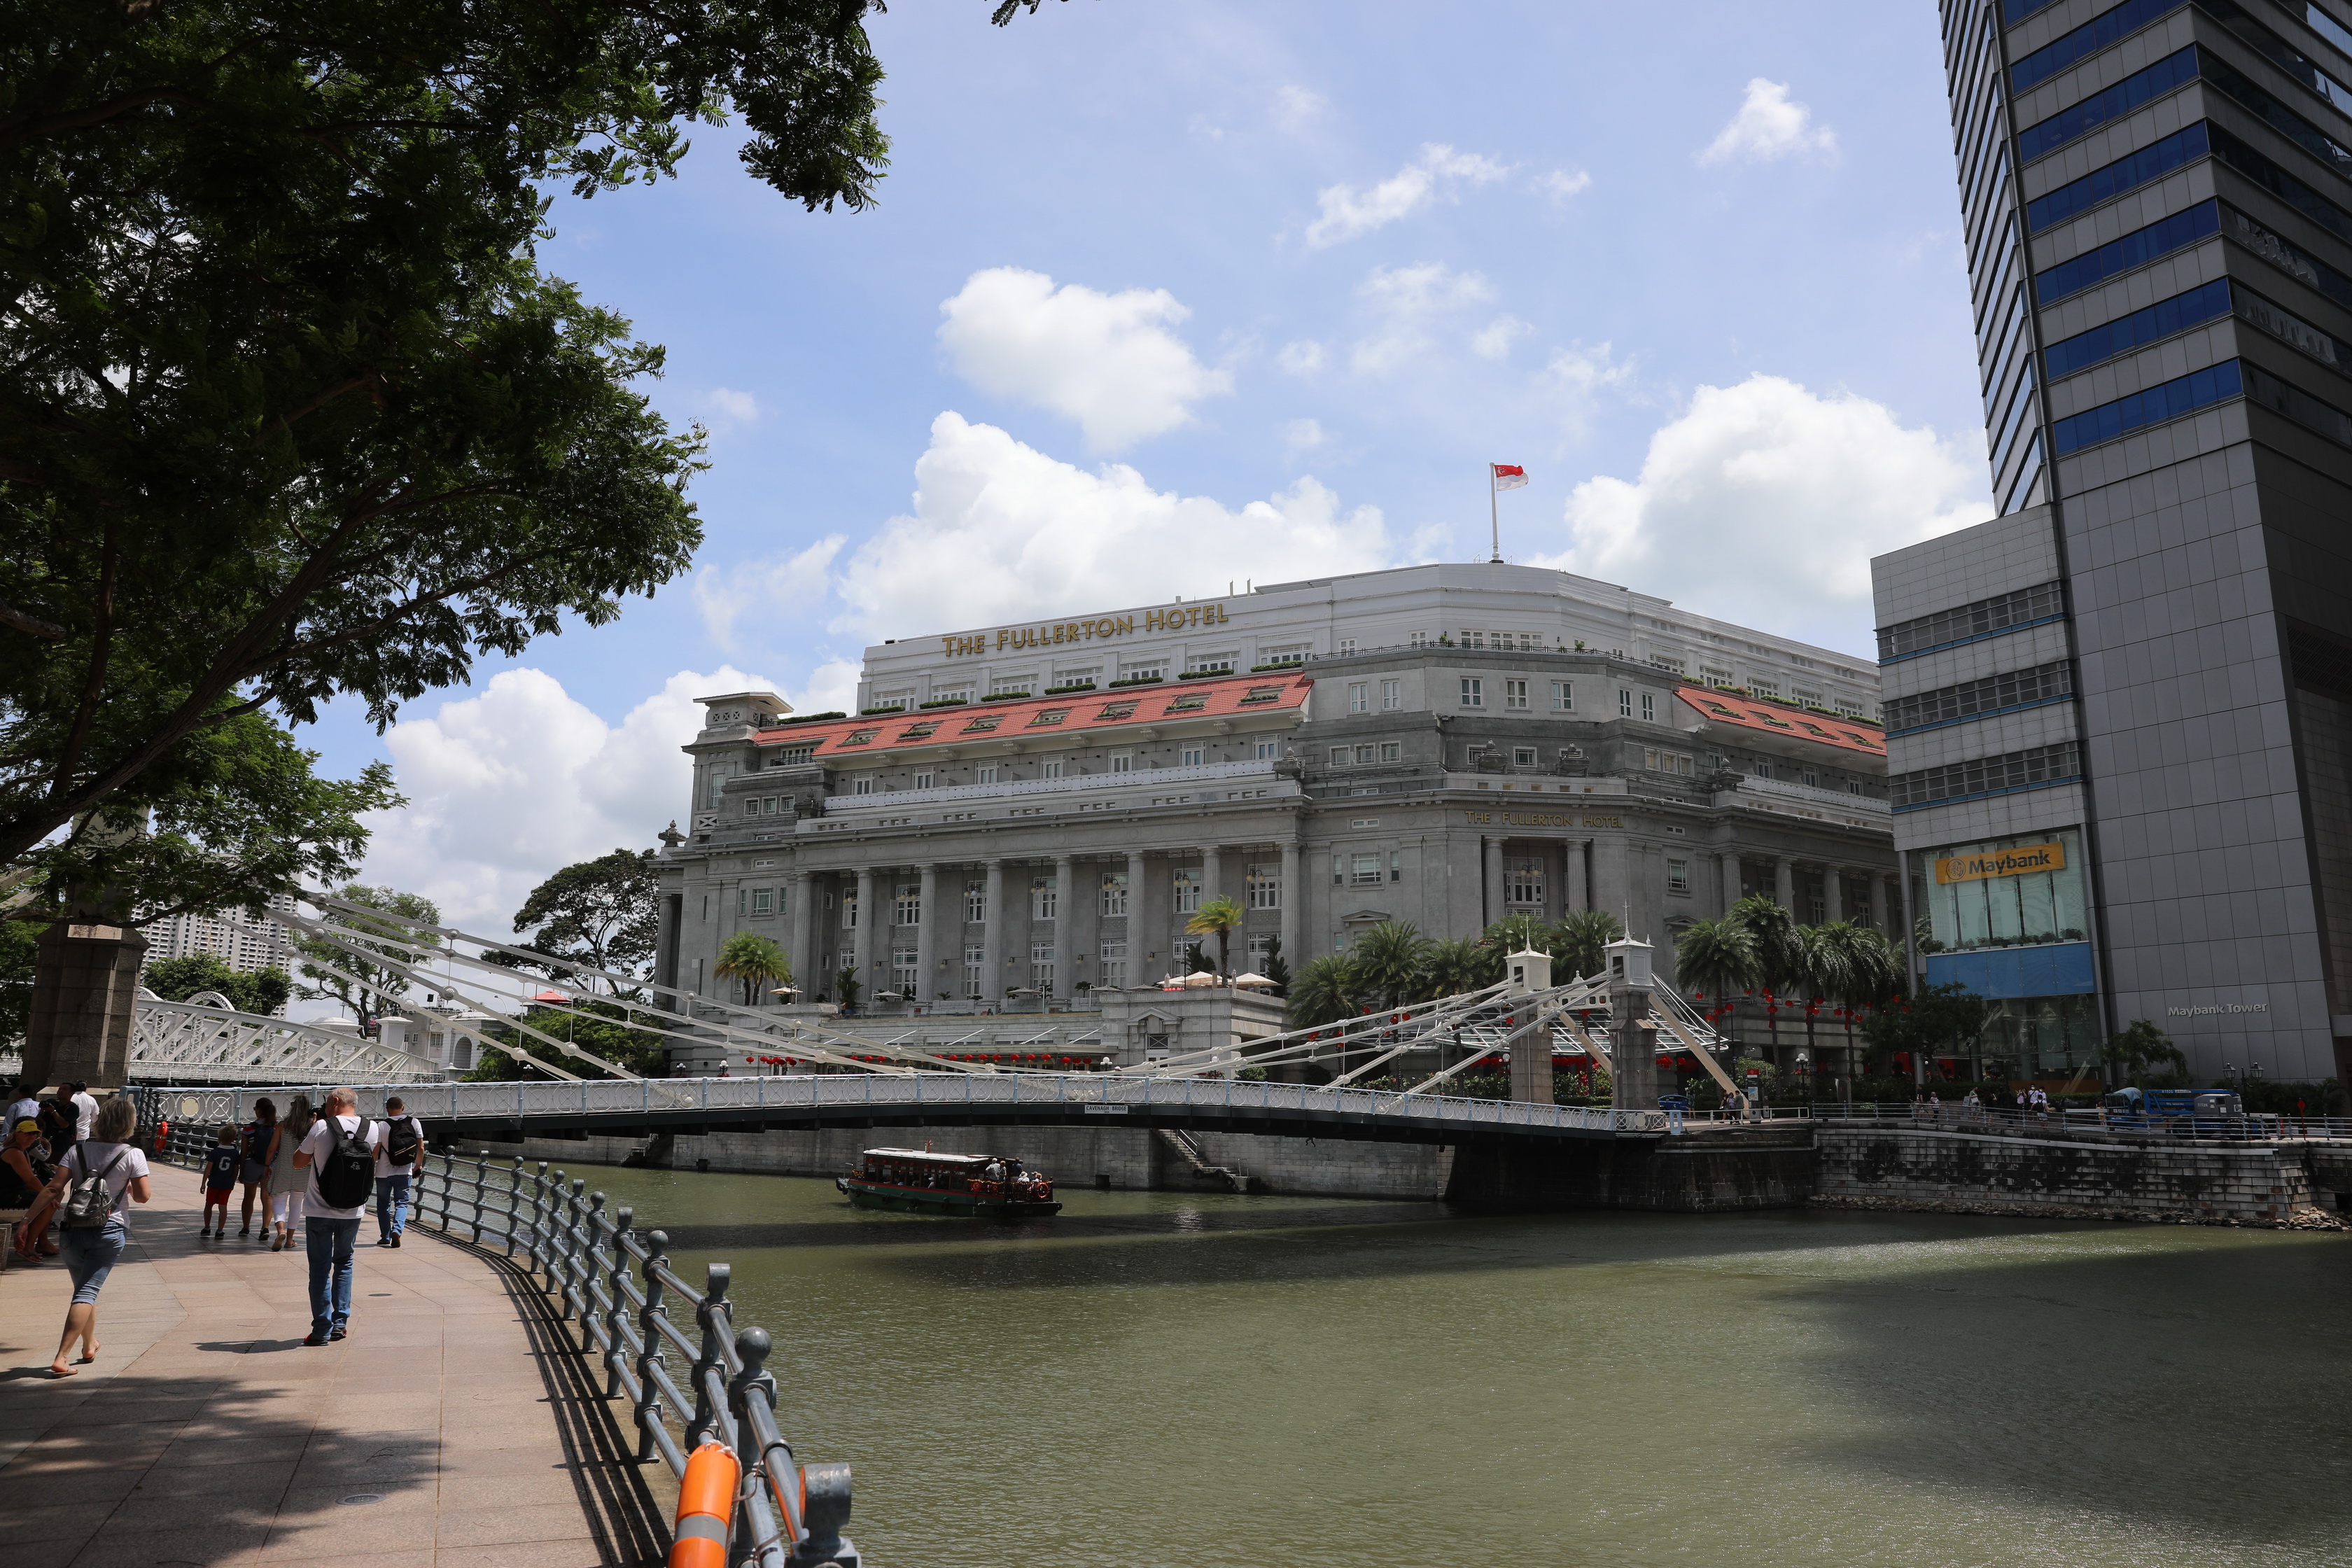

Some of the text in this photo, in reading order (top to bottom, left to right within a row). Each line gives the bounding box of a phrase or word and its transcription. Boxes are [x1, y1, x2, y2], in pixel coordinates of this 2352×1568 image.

[941, 603, 1229, 657] THE FULLERTON HOTEL
[1464, 811, 1624, 828] THE FULLERTON HOTEL
[1968, 849, 2052, 874] Maybank
[2168, 1003, 2267, 1018] Maybank Tower
[218, 1156, 232, 1171] G
